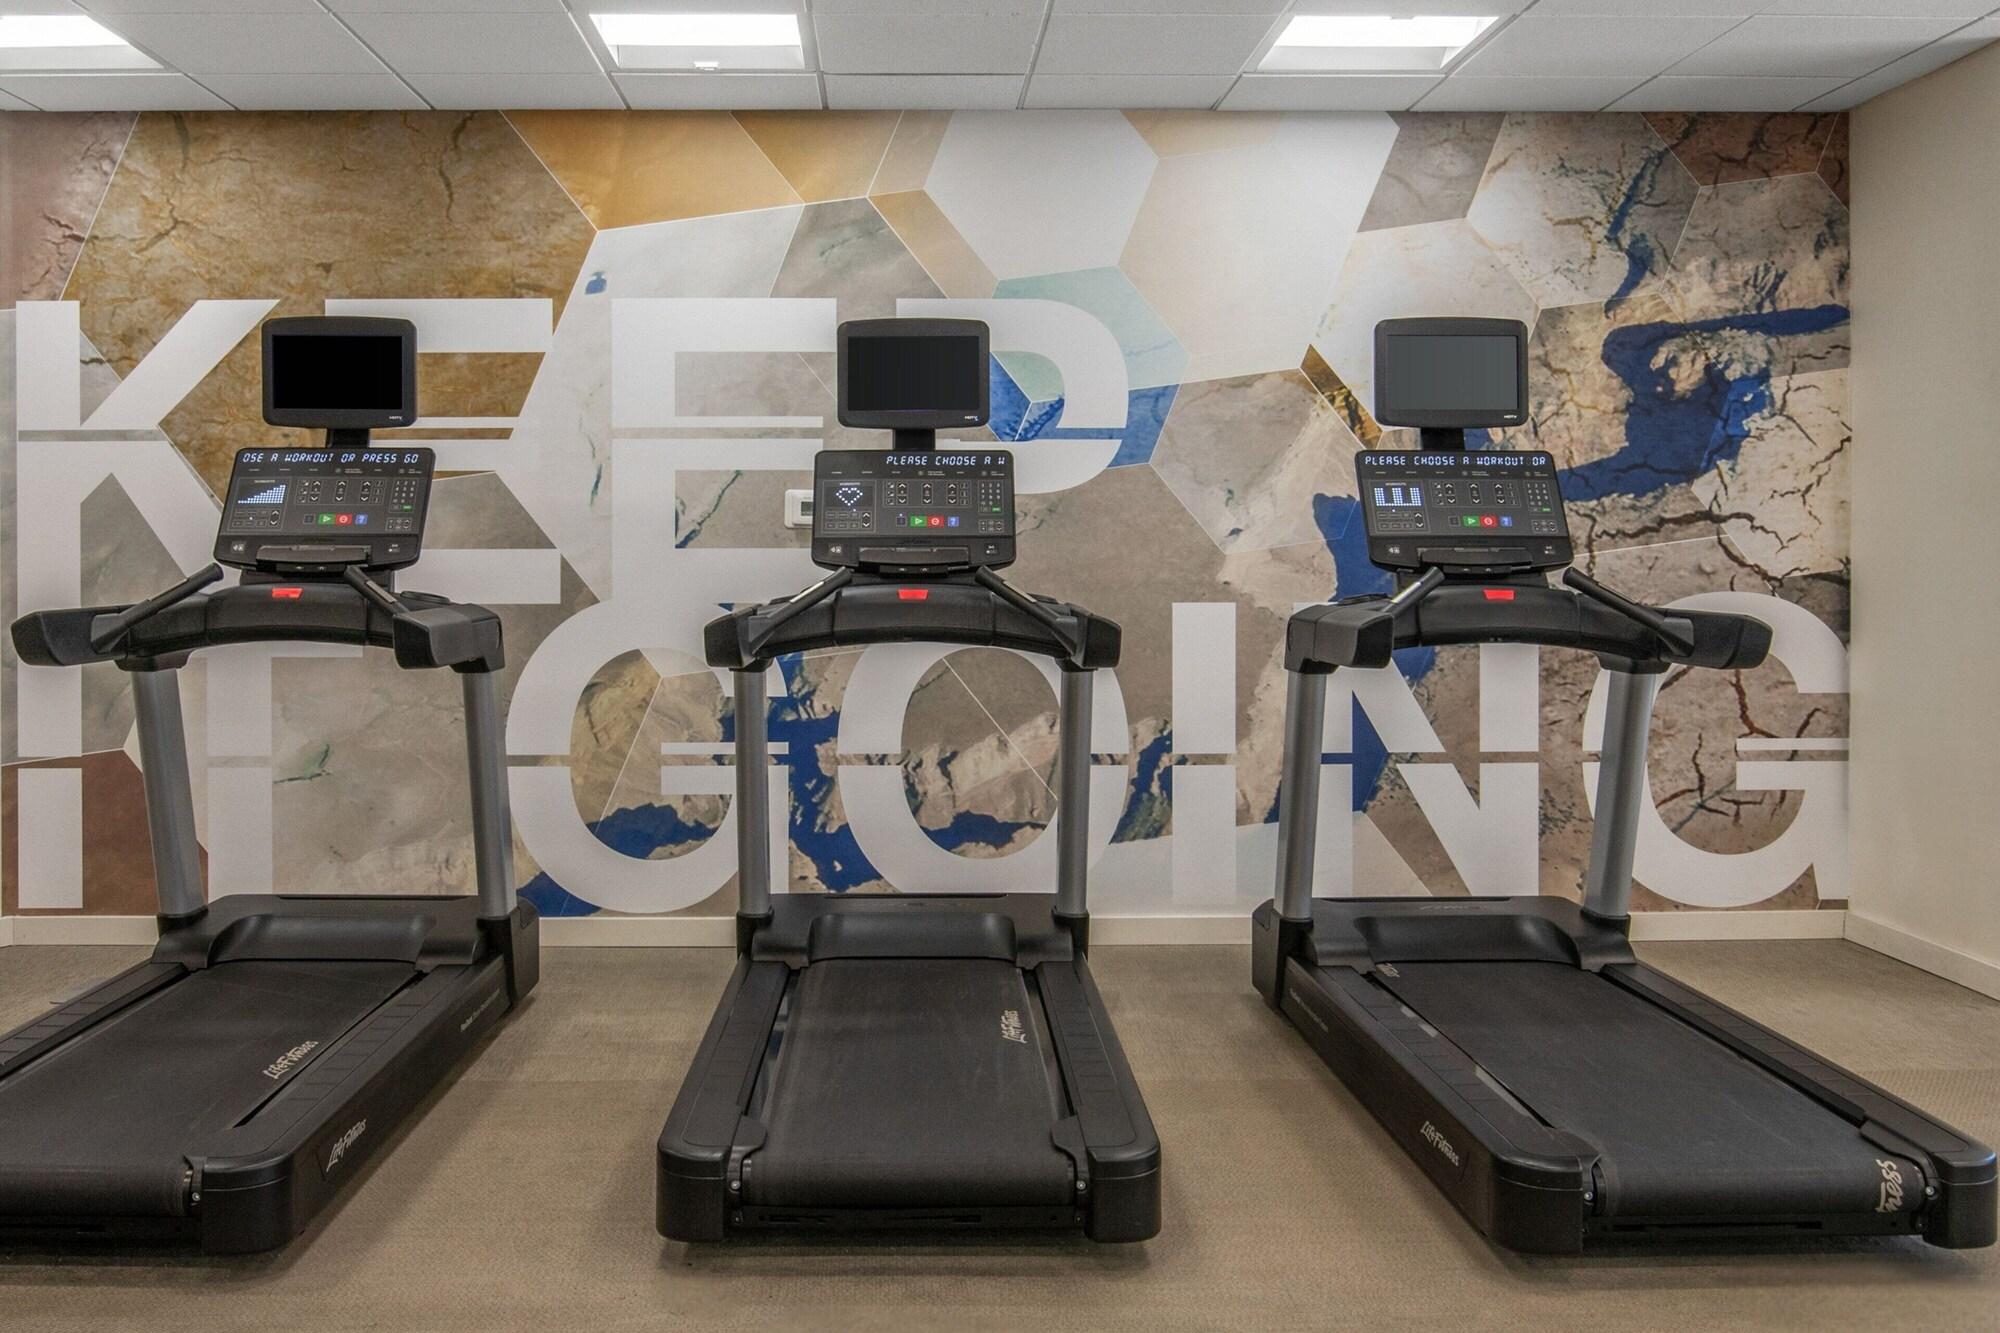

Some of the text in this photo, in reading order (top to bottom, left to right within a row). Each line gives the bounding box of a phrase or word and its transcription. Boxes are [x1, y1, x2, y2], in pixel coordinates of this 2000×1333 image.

[242, 452, 420, 464] OSE A WORKOUT OR PRESS GO
[885, 455, 929, 466] PLEASE
[934, 455, 977, 467] CHOOSE
[983, 455, 992, 465] A
[1364, 455, 1547, 466] PLEASE CHOOSE A WORKOUT OR
[504, 591, 1850, 913] GOING
